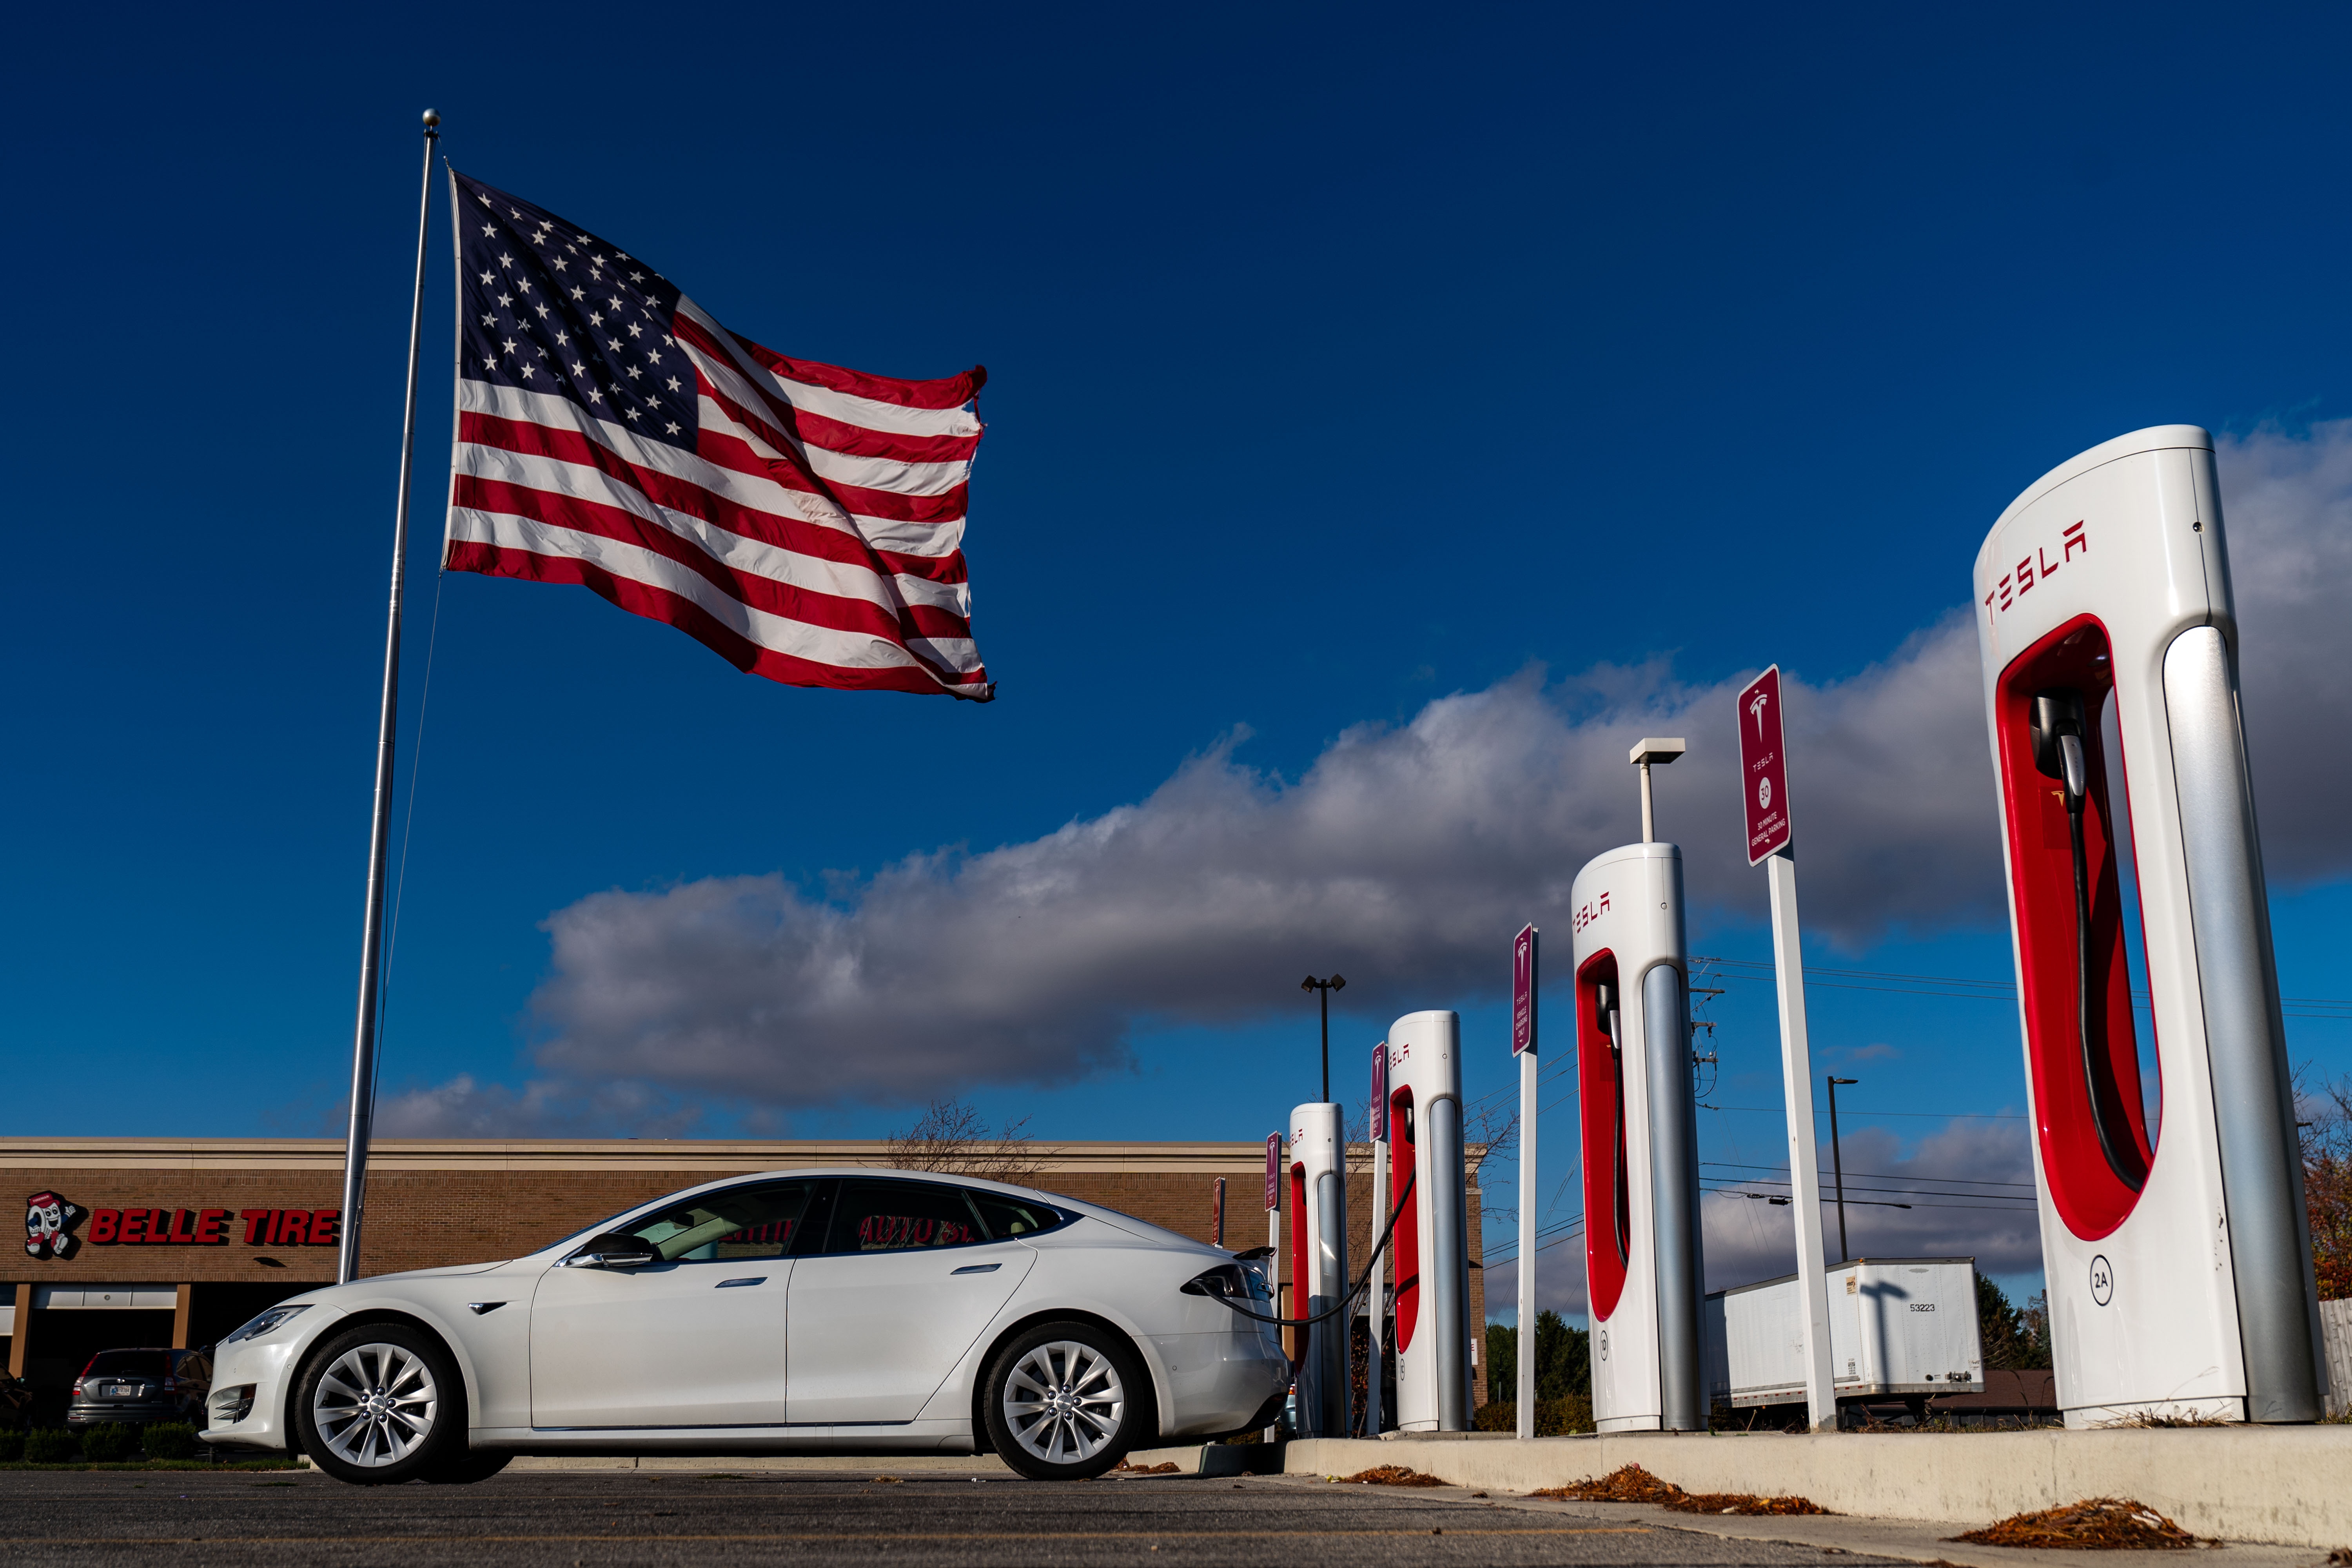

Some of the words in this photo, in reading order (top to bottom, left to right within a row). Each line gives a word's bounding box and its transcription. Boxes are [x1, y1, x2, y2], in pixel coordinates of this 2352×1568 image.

[1985, 520, 2087, 625] TESLA
[1753, 752, 1773, 772] TESLA
[1760, 785, 1769, 800] 30
[1758, 821, 1762, 831] 30
[1763, 811, 1777, 827] MINUTE
[1751, 831, 1769, 846] GENERAL
[1768, 818, 1786, 835] PARKING
[1573, 891, 1610, 939] TESLA
[1517, 991, 1527, 1005] TESLA
[1516, 1014, 1527, 1030] CHARGING
[1517, 1006, 1526, 1019] VEHICLE
[1389, 1044, 1409, 1071] ESLA
[87, 1209, 225, 1243] BELLE
[241, 1209, 340, 1243] TIRE
[2094, 1272, 2108, 1288] 2A
